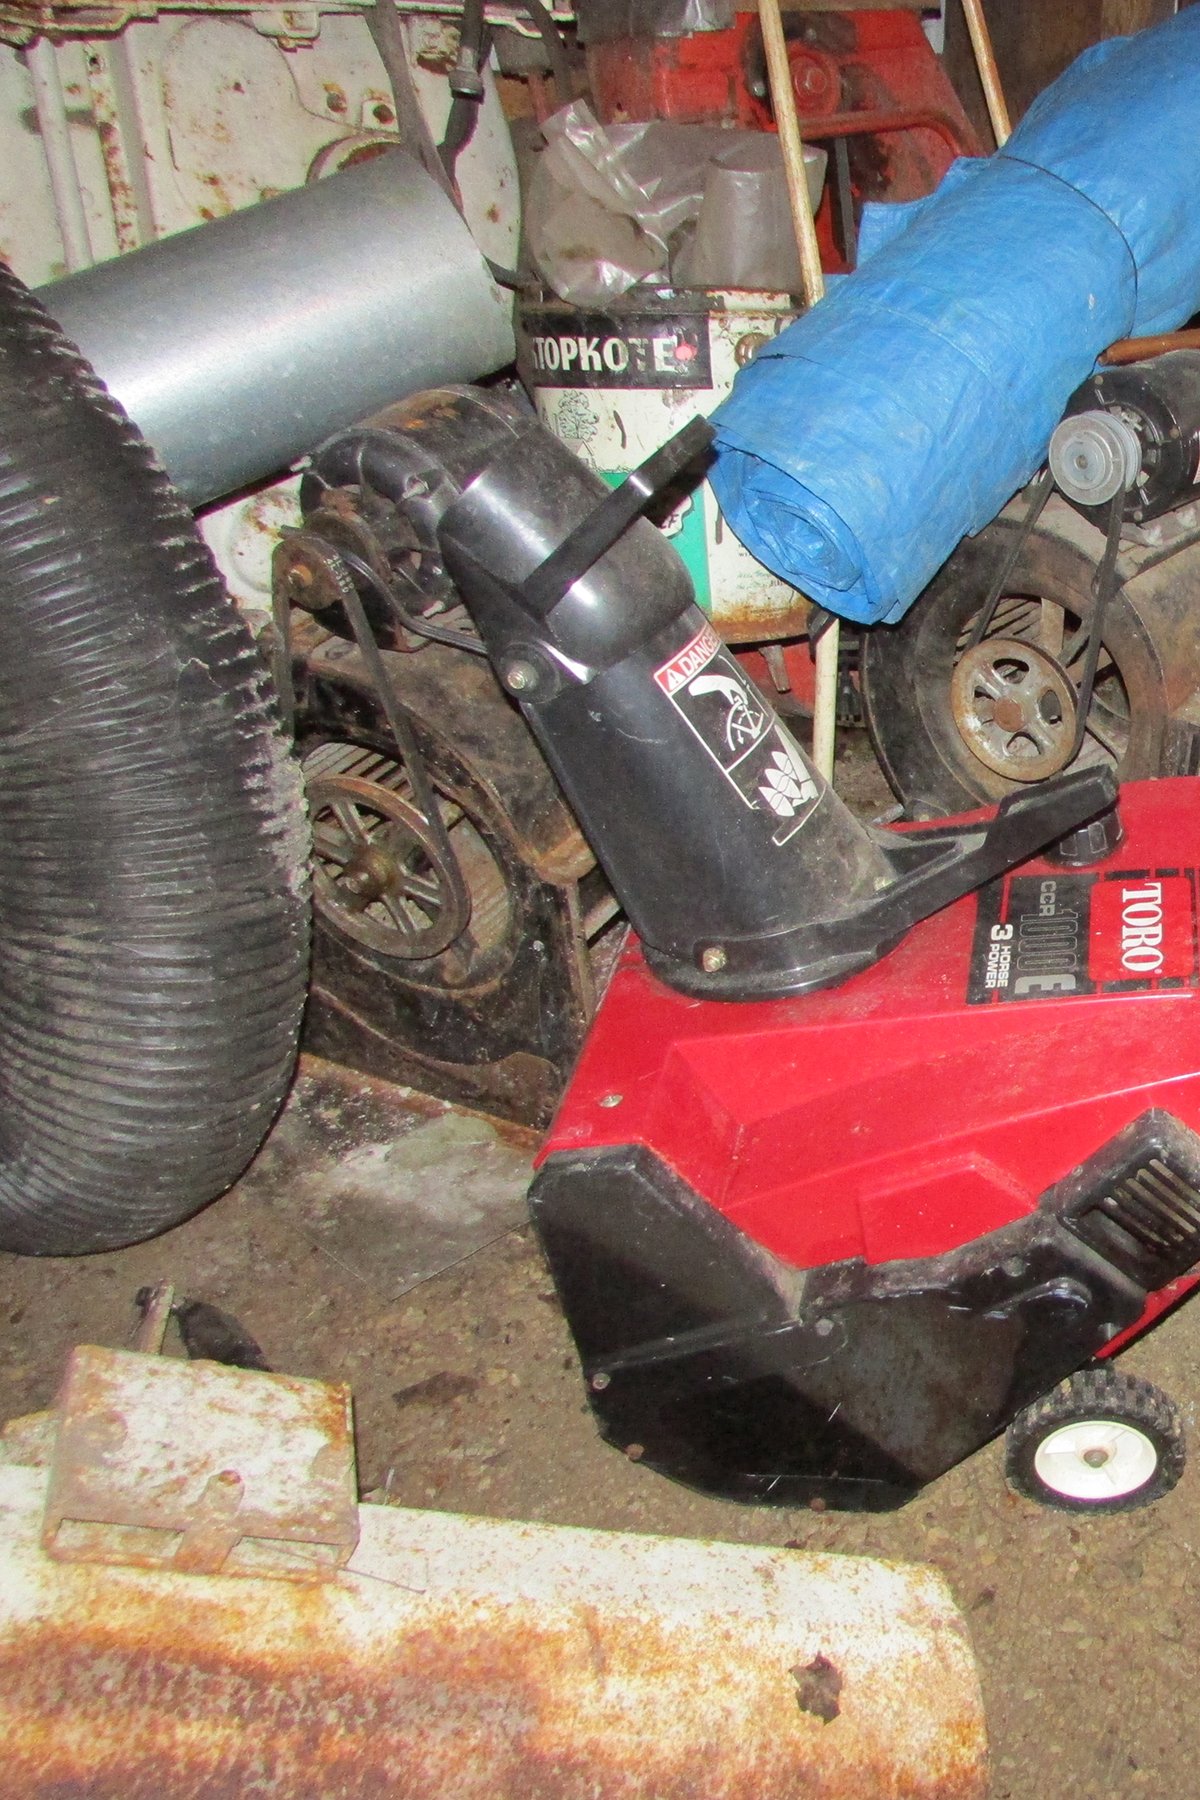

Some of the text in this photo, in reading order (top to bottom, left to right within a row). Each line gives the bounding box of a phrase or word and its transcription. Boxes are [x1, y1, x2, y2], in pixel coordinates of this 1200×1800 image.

[678, 627, 720, 679] DANGE
[990, 923, 1014, 988] 3 HORSE
[1121, 882, 1164, 972] TORO
[984, 943, 999, 989] POWER
